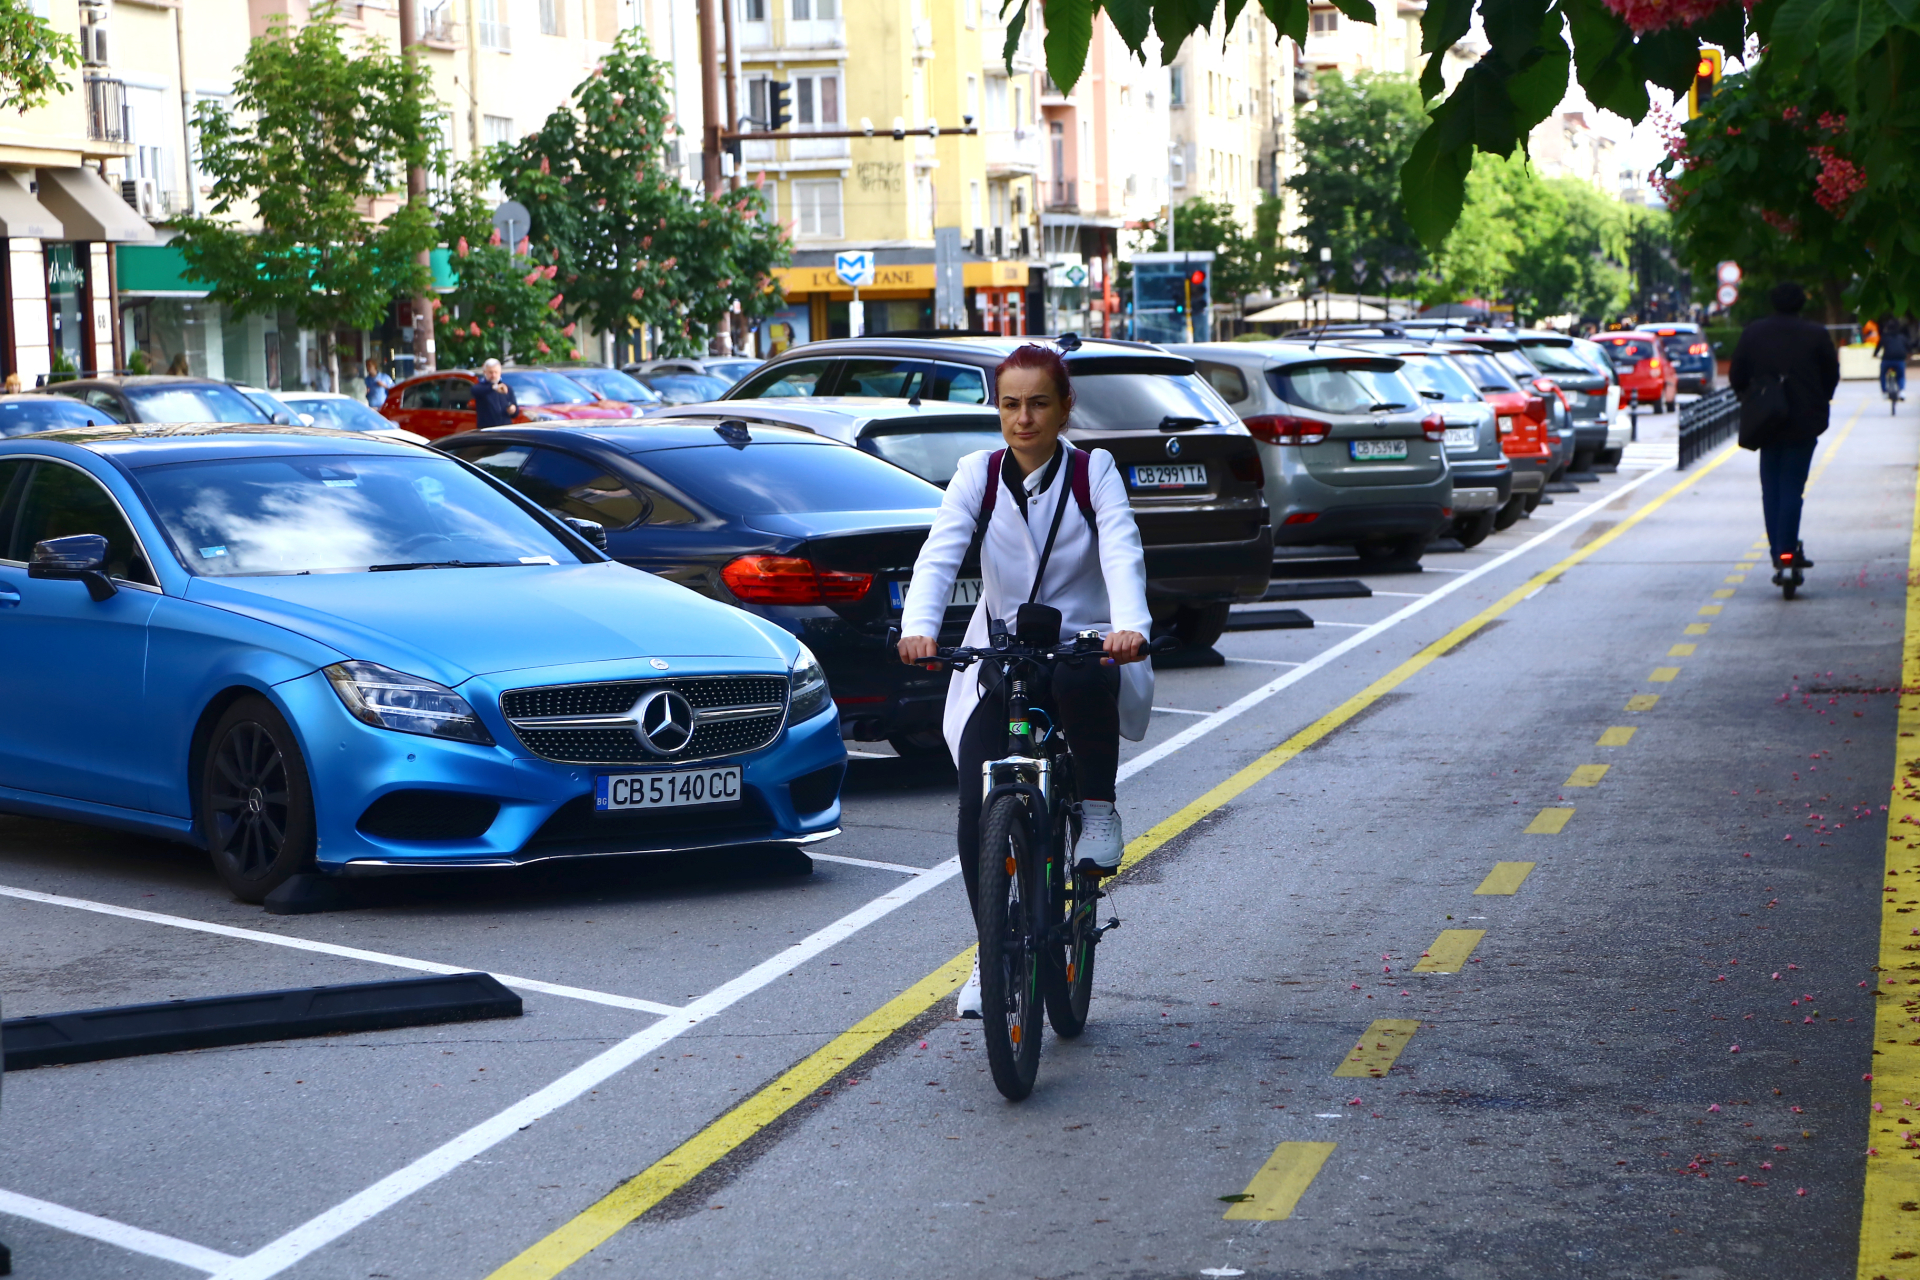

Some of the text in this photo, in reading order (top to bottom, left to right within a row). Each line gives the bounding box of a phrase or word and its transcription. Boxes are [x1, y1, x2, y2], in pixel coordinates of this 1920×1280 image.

[1137, 466, 1205, 483] CB 2991 TA
[596, 771, 737, 806] BG CB 5140 CC
